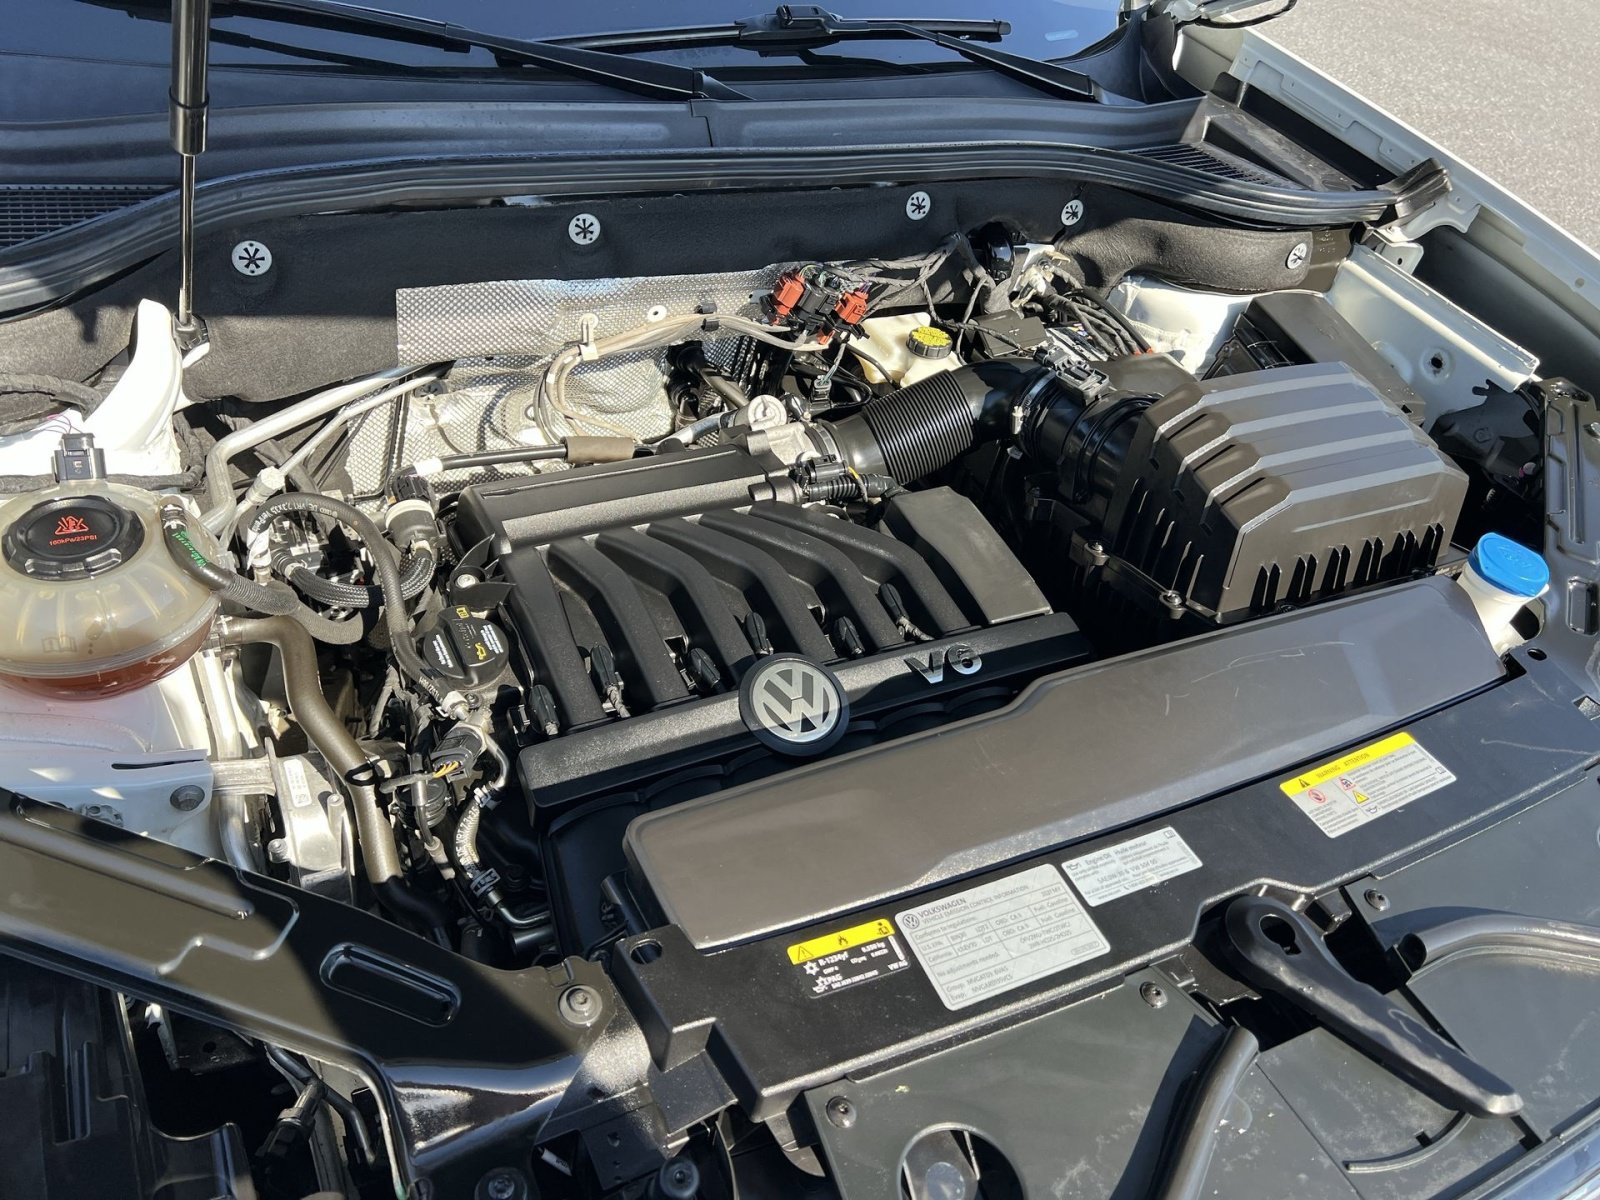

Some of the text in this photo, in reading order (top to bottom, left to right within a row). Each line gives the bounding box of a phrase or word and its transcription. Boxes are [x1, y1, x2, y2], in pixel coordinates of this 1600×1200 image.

[904, 643, 982, 684] V6
[917, 897, 967, 918] VOLKSWAGEN
[969, 896, 993, 908] CONTROL
[992, 884, 1029, 900] INFORMATION
